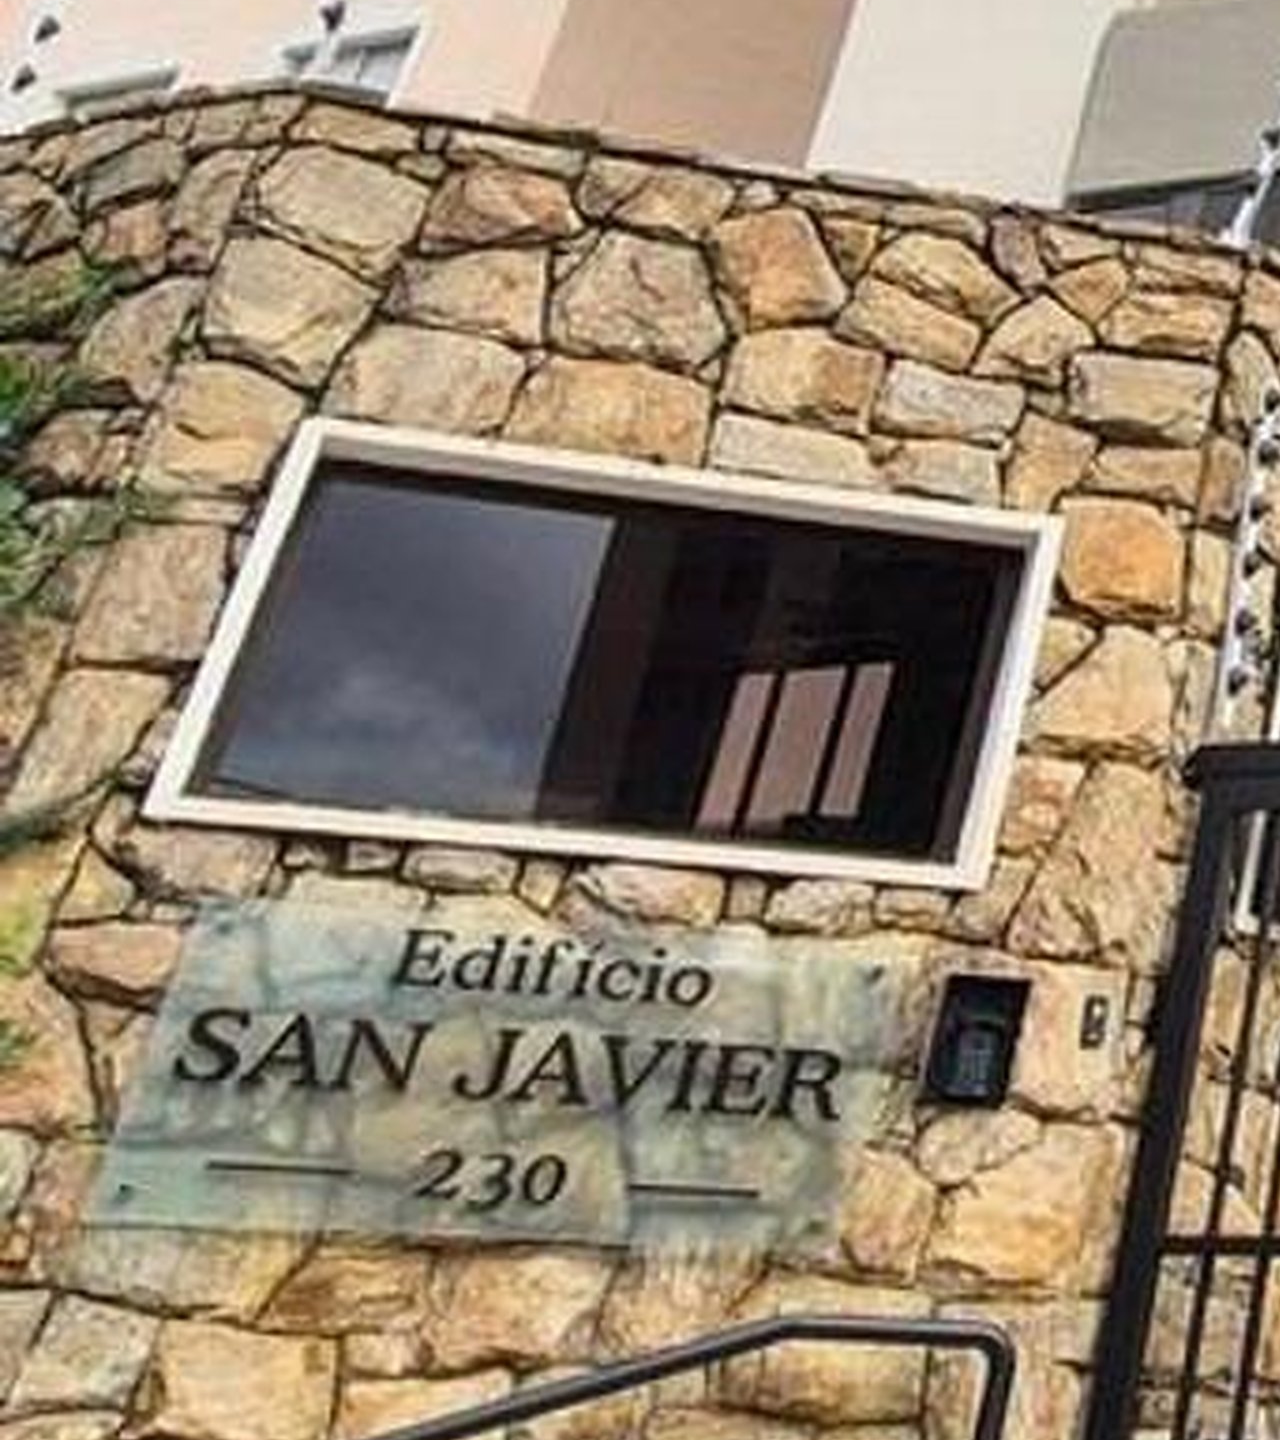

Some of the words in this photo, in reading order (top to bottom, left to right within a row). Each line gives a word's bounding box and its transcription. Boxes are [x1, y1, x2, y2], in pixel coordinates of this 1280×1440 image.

[394, 928, 714, 1007] Edifício
[173, 1008, 428, 1093] SAN
[454, 1027, 844, 1121] JAVIER
[416, 1149, 568, 1213] 230
